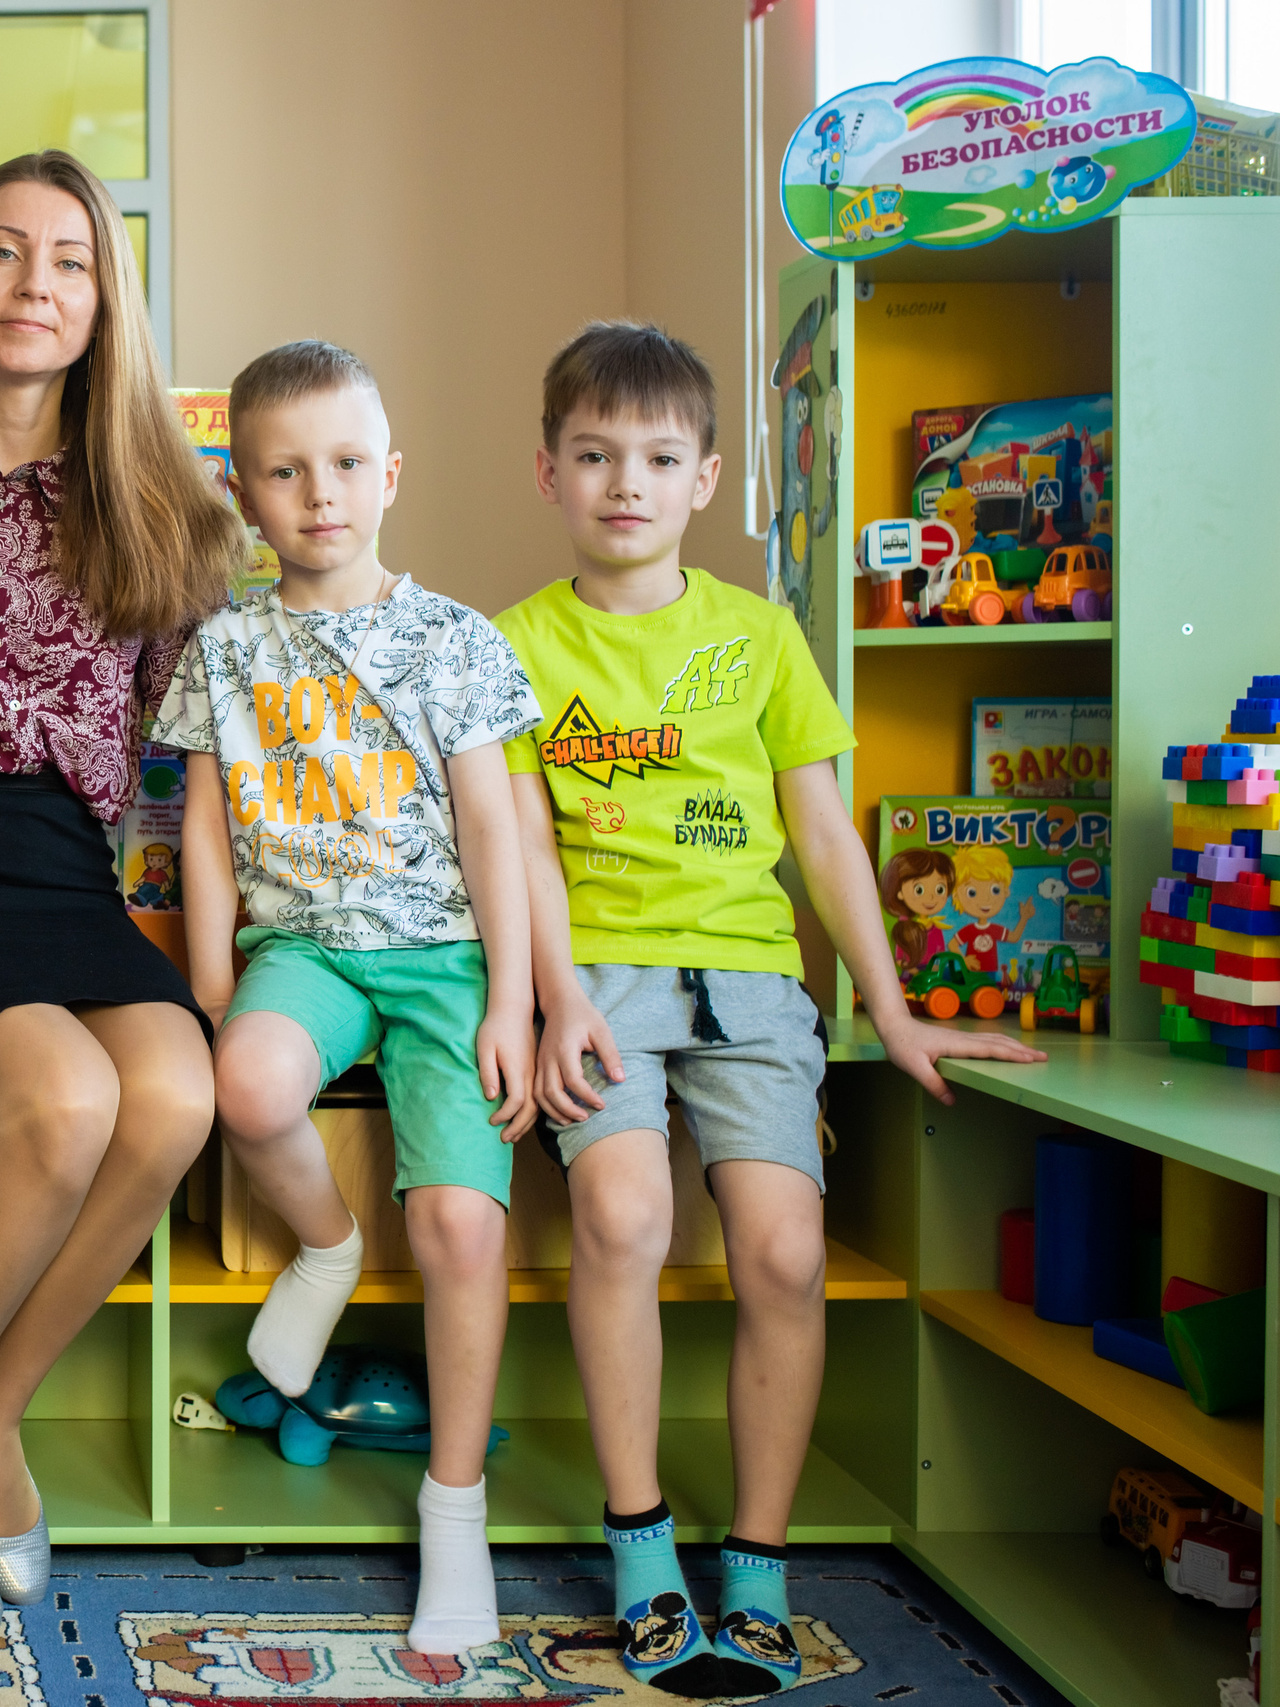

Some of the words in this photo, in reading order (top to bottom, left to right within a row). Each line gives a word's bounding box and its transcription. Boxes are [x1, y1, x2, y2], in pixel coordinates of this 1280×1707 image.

[963, 91, 1092, 134] УГОЛОК
[901, 109, 1164, 175] БЕЗОПАСНОСТИ
[921, 422, 957, 436] ДОМОЙ
[1032, 422, 1070, 449] ШКОЛА
[254, 674, 382, 749] BOY-
[1025, 708, 1058, 719] ИГРА
[228, 751, 417, 826] CHAMP
[684, 798, 743, 823] ВЛАД
[675, 824, 747, 848] БУМАГА
[603, 1518, 675, 1543] MICKEY
[721, 1552, 786, 1574] MICK
